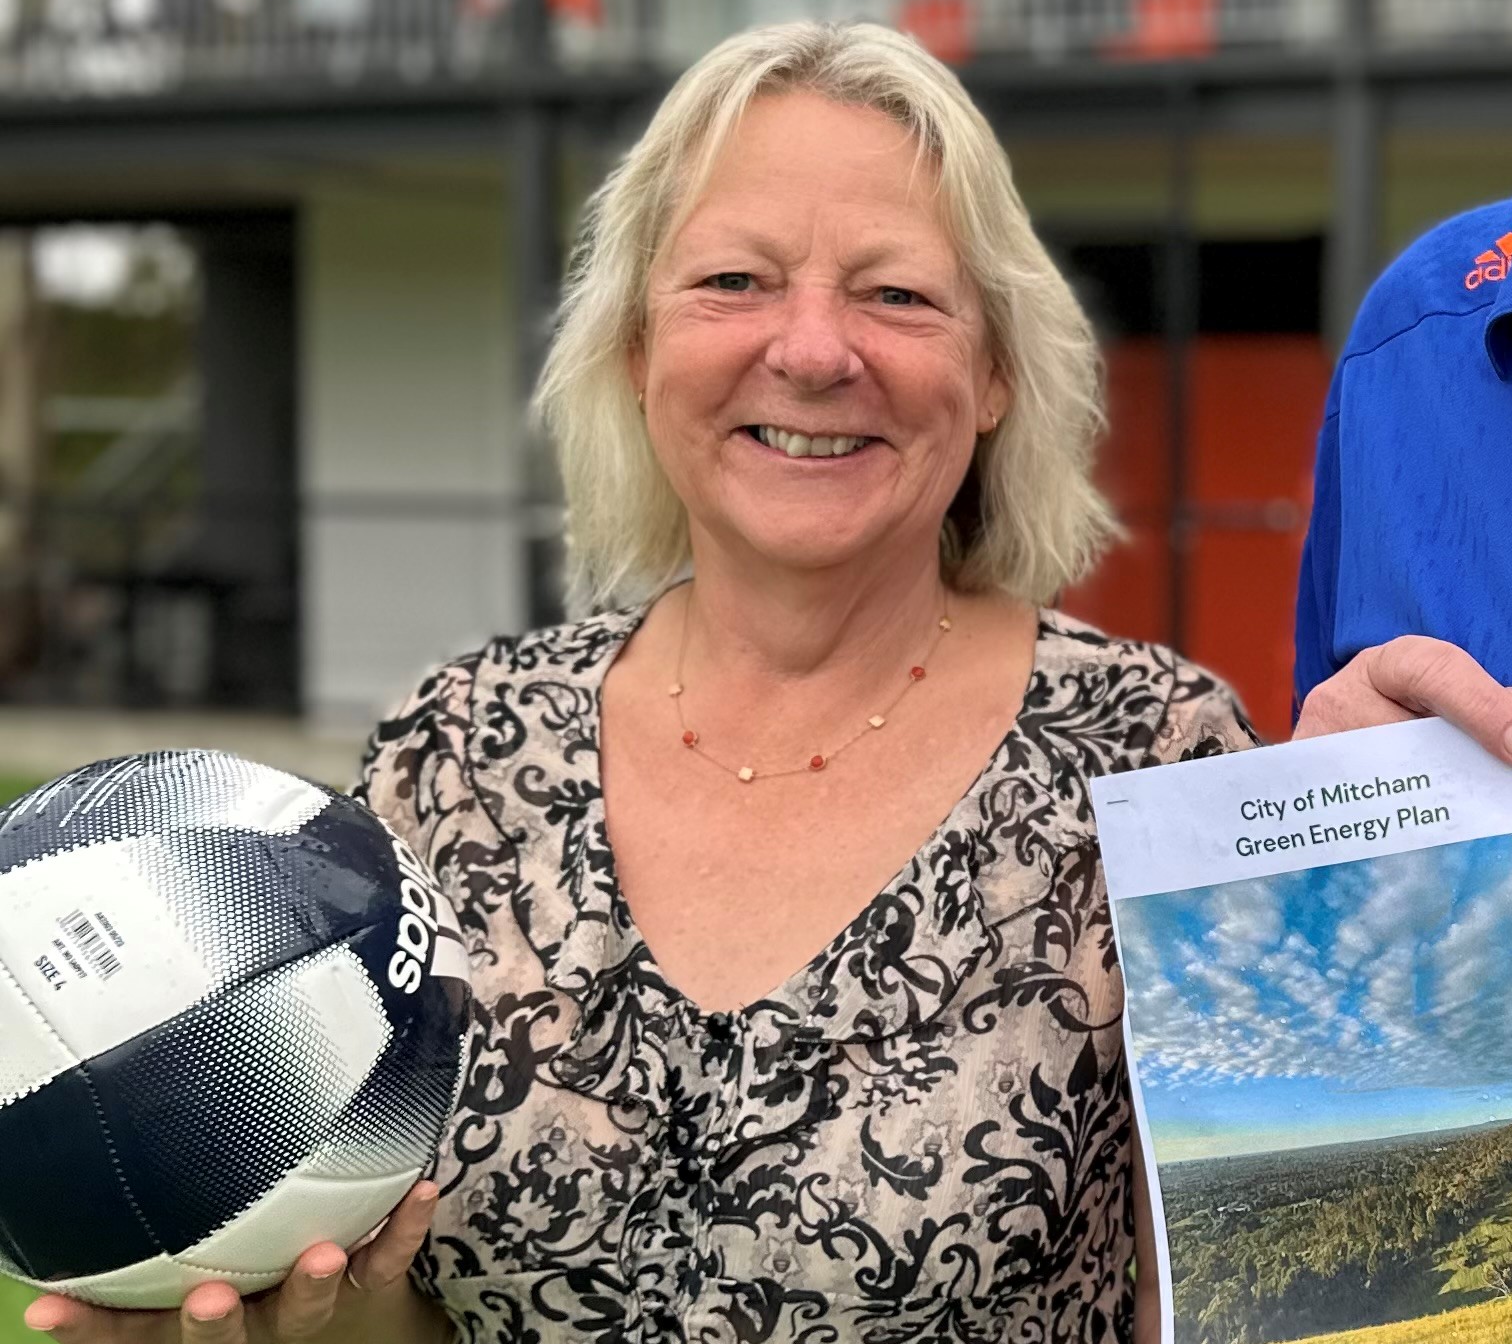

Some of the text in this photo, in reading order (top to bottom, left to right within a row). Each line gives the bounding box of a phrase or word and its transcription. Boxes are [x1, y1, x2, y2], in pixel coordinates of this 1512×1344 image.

[1240, 773, 1431, 821] City of Mitcham
[1235, 805, 1450, 857] Green Energy Plan
[33, 954, 67, 991] SIZE 4
